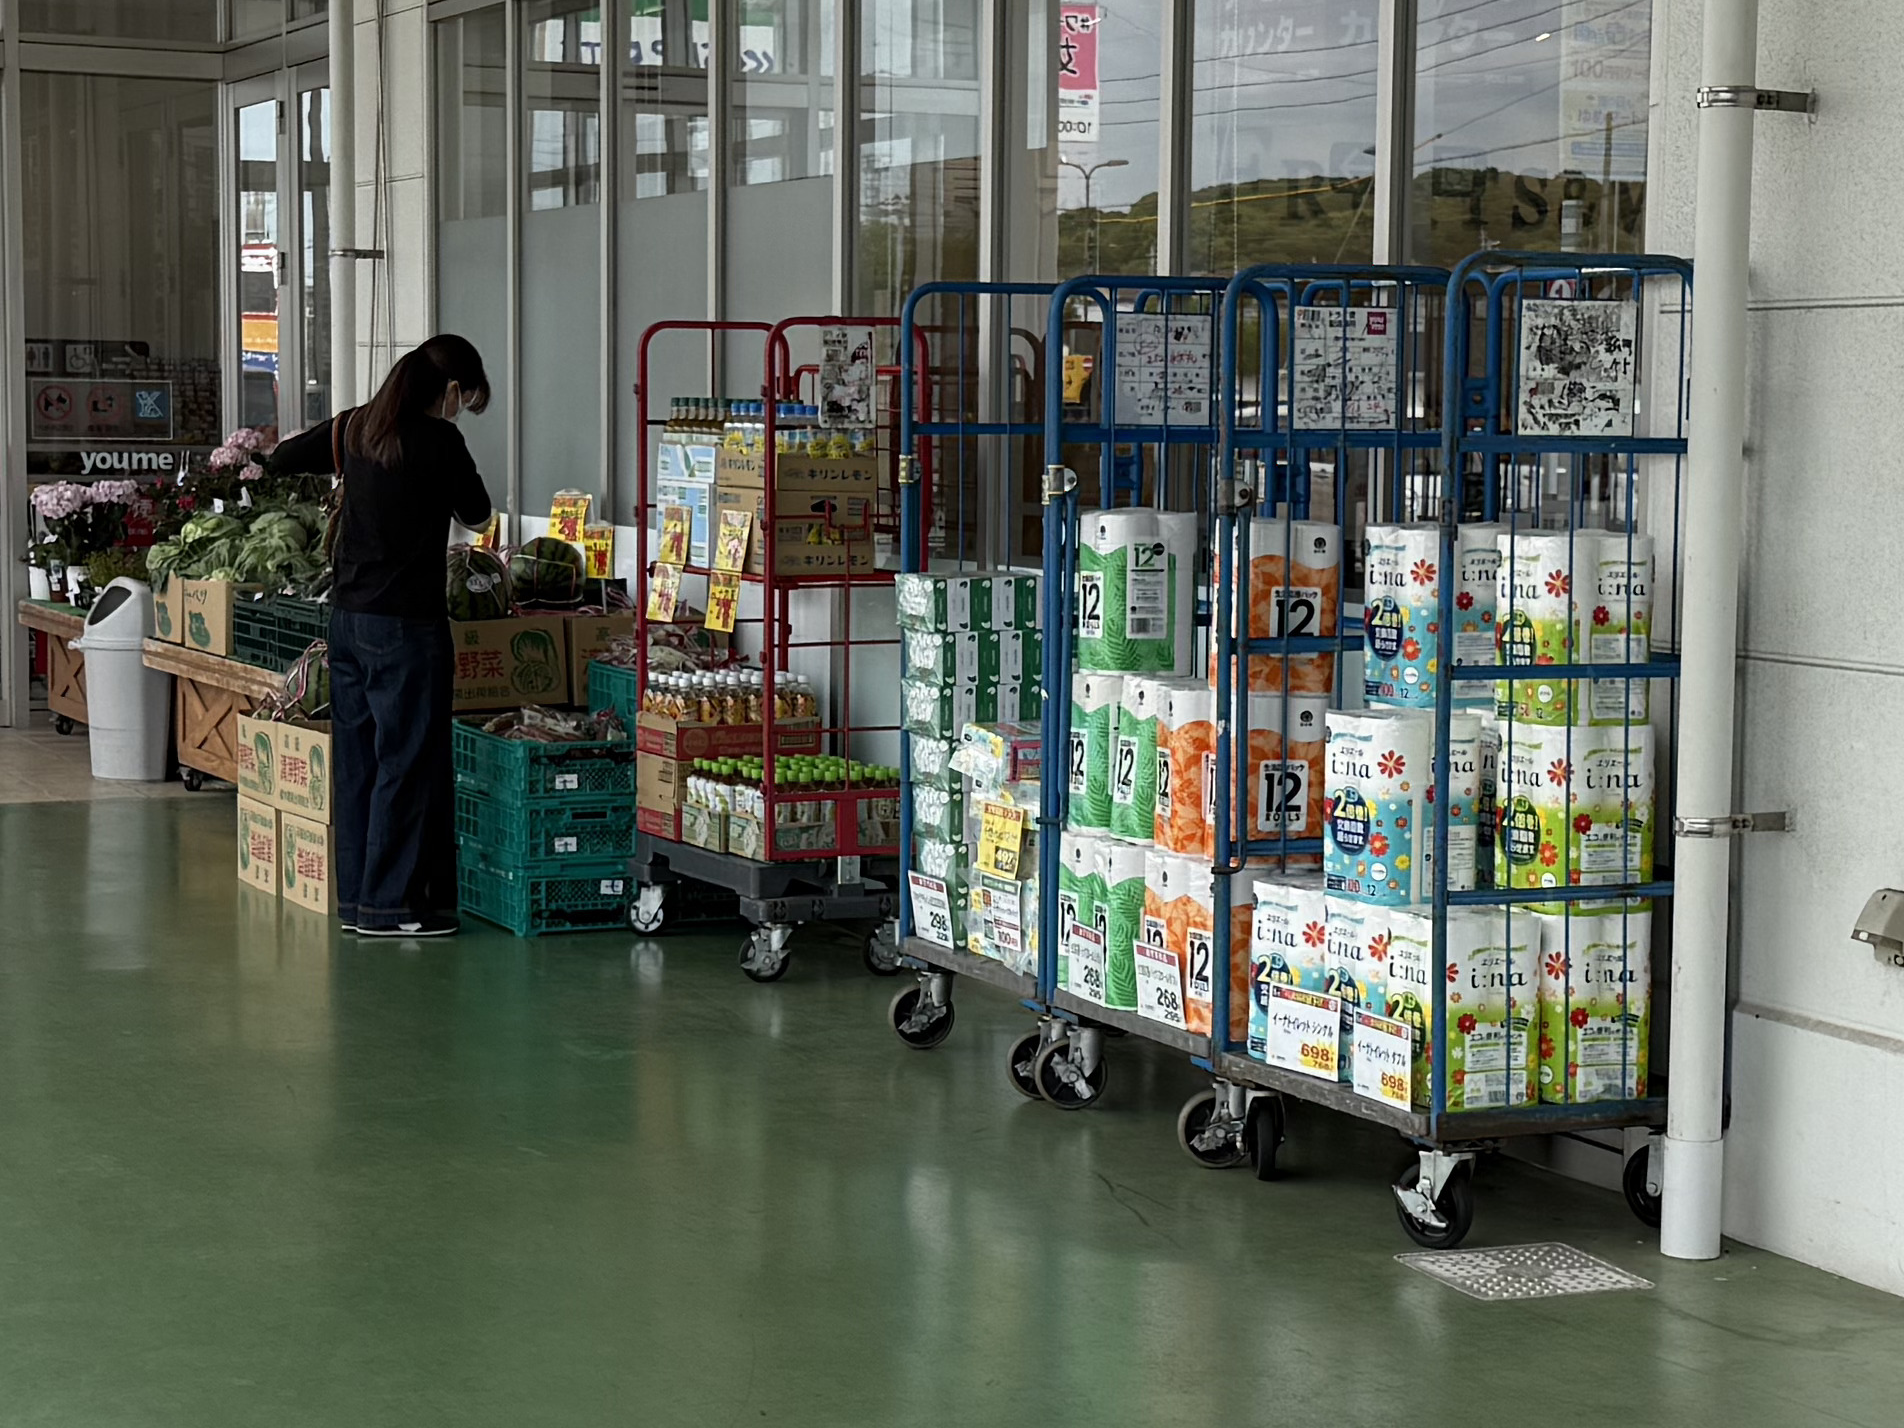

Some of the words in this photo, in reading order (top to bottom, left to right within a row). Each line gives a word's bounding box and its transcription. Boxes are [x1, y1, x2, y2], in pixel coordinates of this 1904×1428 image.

[80, 451, 174, 475] youme
[807, 468, 873, 482] キリンレモン
[803, 554, 870, 567] キリンレモン
[1134, 545, 1154, 568] 12
[1081, 582, 1101, 621] 12
[1118, 745, 1135, 785] 12
[1264, 772, 1302, 813] 12
[1188, 939, 1210, 989] 12
[1470, 967, 1528, 989] i:na
[1156, 986, 1178, 1011] 268
[1301, 1043, 1330, 1063] 698
[1381, 1072, 1405, 1092] 698
